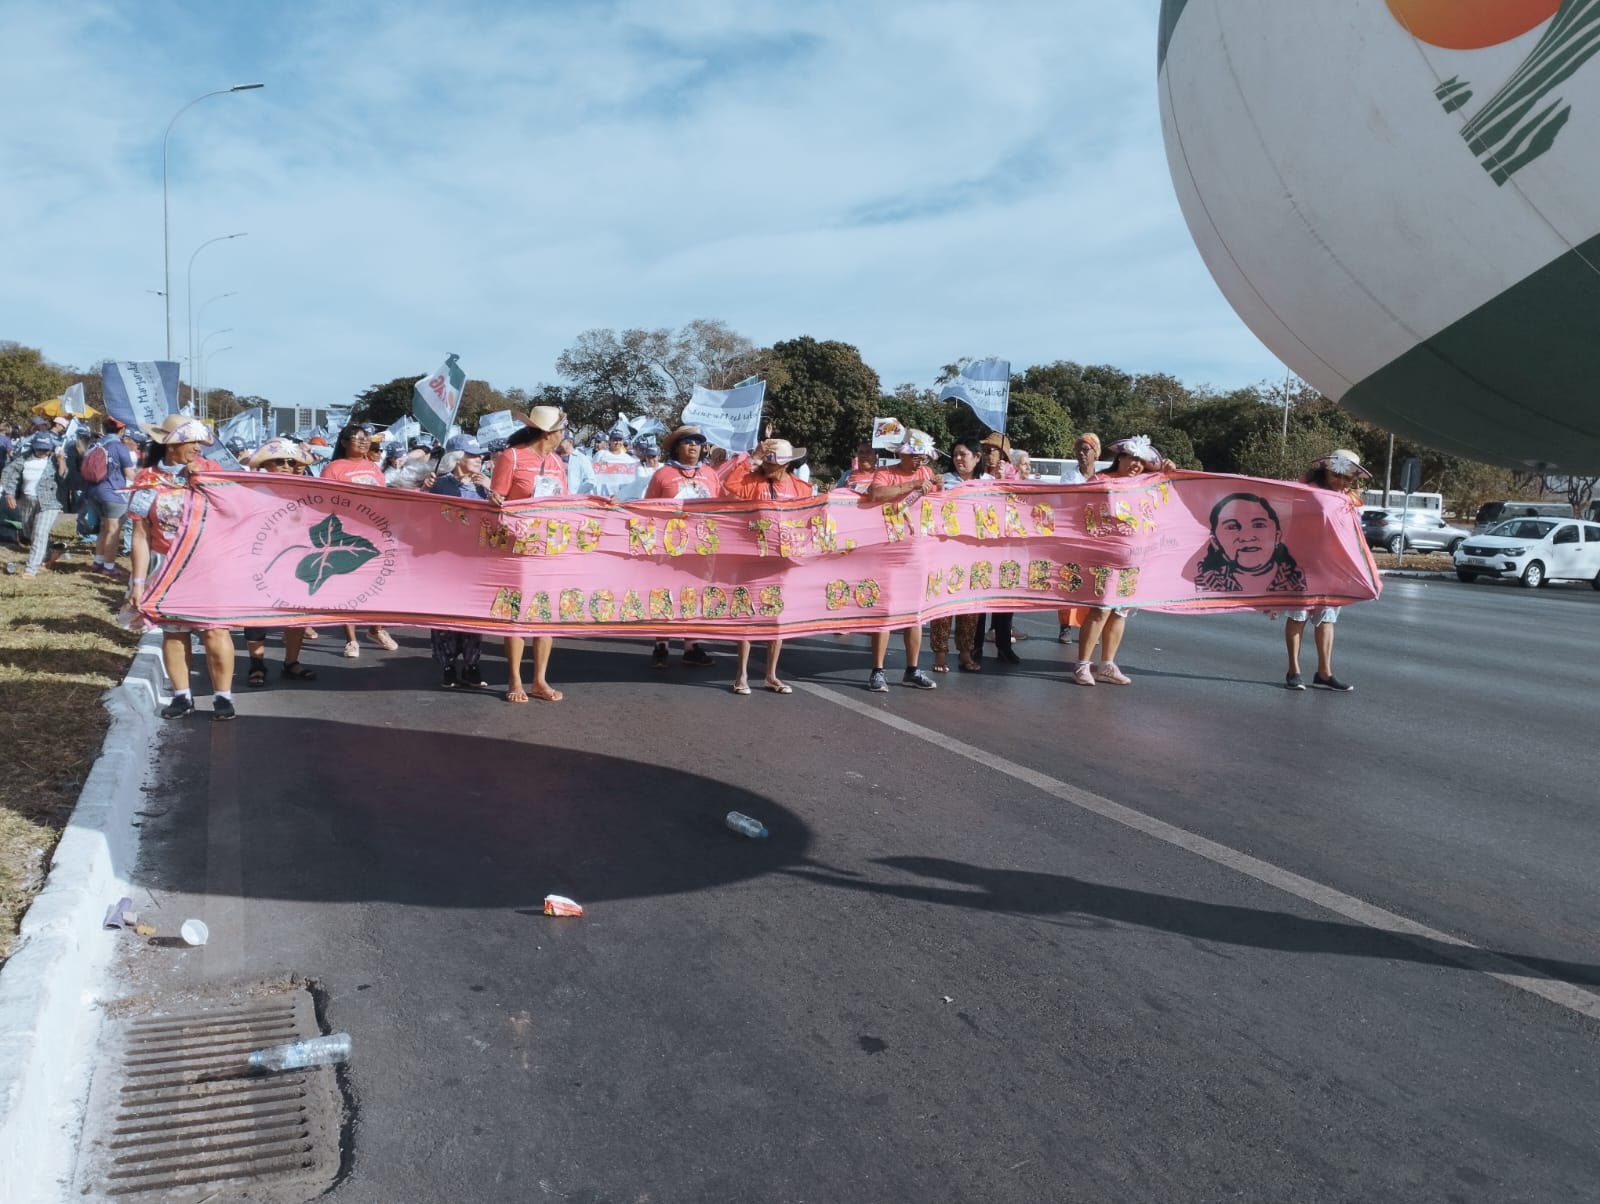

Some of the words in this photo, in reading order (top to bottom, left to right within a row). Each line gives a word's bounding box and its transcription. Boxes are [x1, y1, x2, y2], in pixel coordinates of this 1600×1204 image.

[250, 493, 324, 556] movimento
[331, 494, 351, 508] da
[355, 503, 395, 545] mulher
[629, 517, 720, 557] NOS
[882, 499, 960, 543] MAS
[973, 494, 1056, 540] NÃO
[322, 548, 397, 610] trabalhado
[490, 585, 785, 623] MARGARIDAS
[826, 578, 881, 610] DO
[926, 559, 1140, 601] NORDESTE
